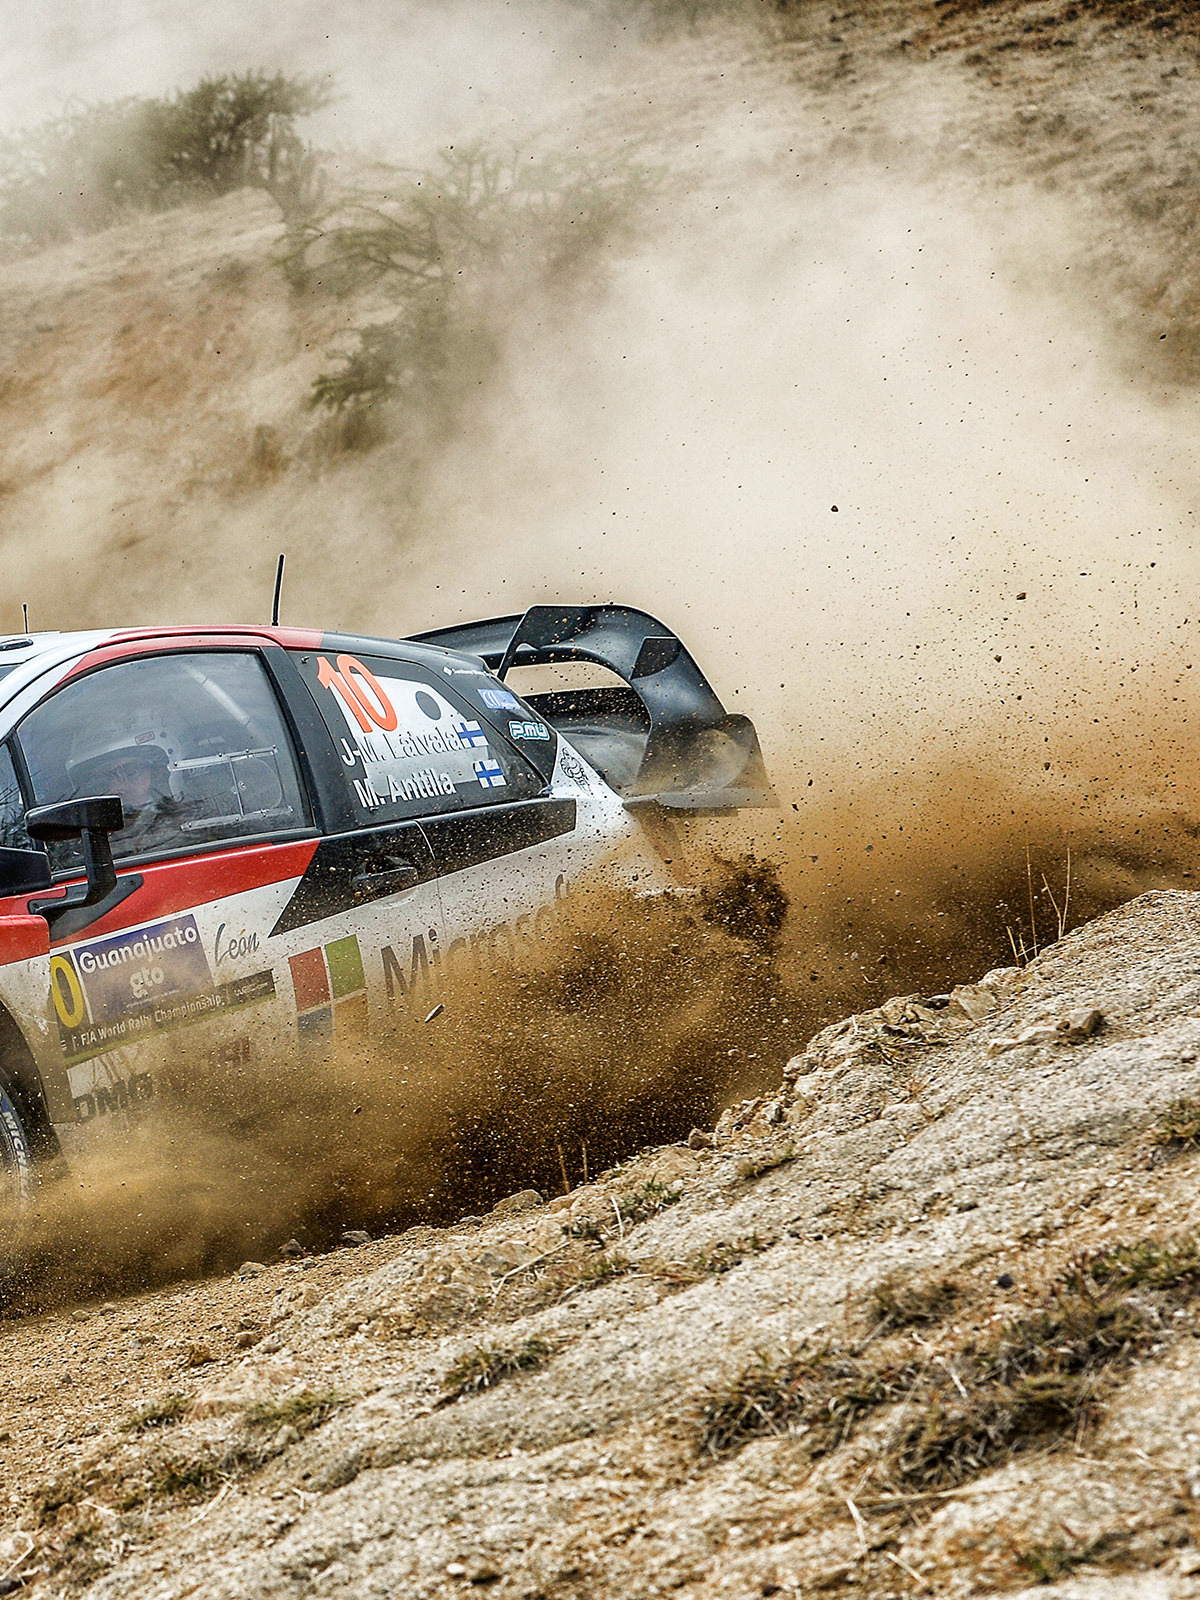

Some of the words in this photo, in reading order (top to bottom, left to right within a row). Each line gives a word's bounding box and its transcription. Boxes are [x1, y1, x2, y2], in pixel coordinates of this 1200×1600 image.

[316, 653, 399, 733] 10
[353, 777, 387, 809] M.
[390, 766, 459, 804] Anttila
[78, 924, 199, 975] Guanajuato
[214, 921, 261, 968] León
[80, 1032, 98, 1047] FIA
[98, 1022, 128, 1040] World
[128, 1013, 152, 1031] Rally
[154, 993, 222, 1023] Championship
